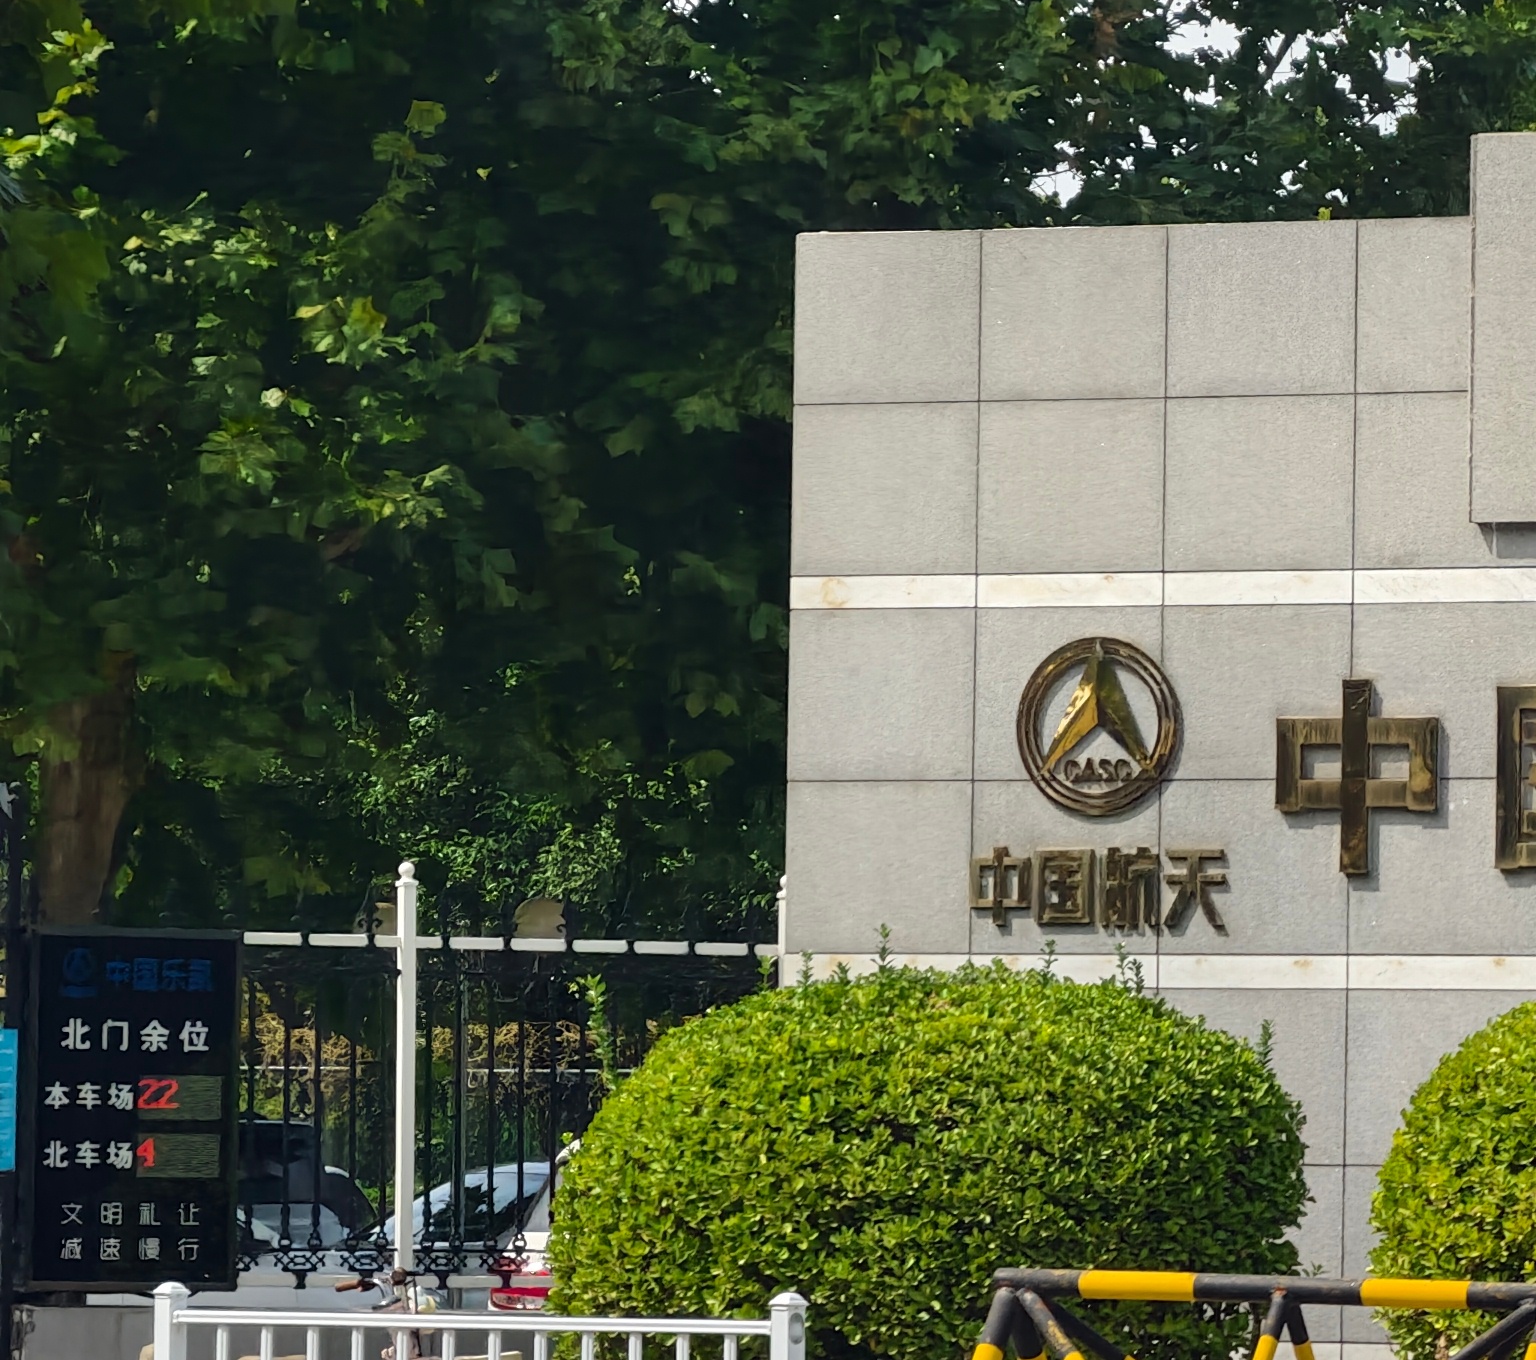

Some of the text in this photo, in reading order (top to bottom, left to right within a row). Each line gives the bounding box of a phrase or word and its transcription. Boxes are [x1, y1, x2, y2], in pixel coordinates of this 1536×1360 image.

[1064, 757, 1133, 783] CASC
[969, 846, 1229, 934] 中国航天
[60, 1017, 210, 1053] 北门余位
[44, 1078, 180, 1110] 本车场 22
[43, 1137, 156, 1169] 北车场 4
[61, 1202, 201, 1226] 文明礼让
[60, 1237, 200, 1261] 减速慢行
